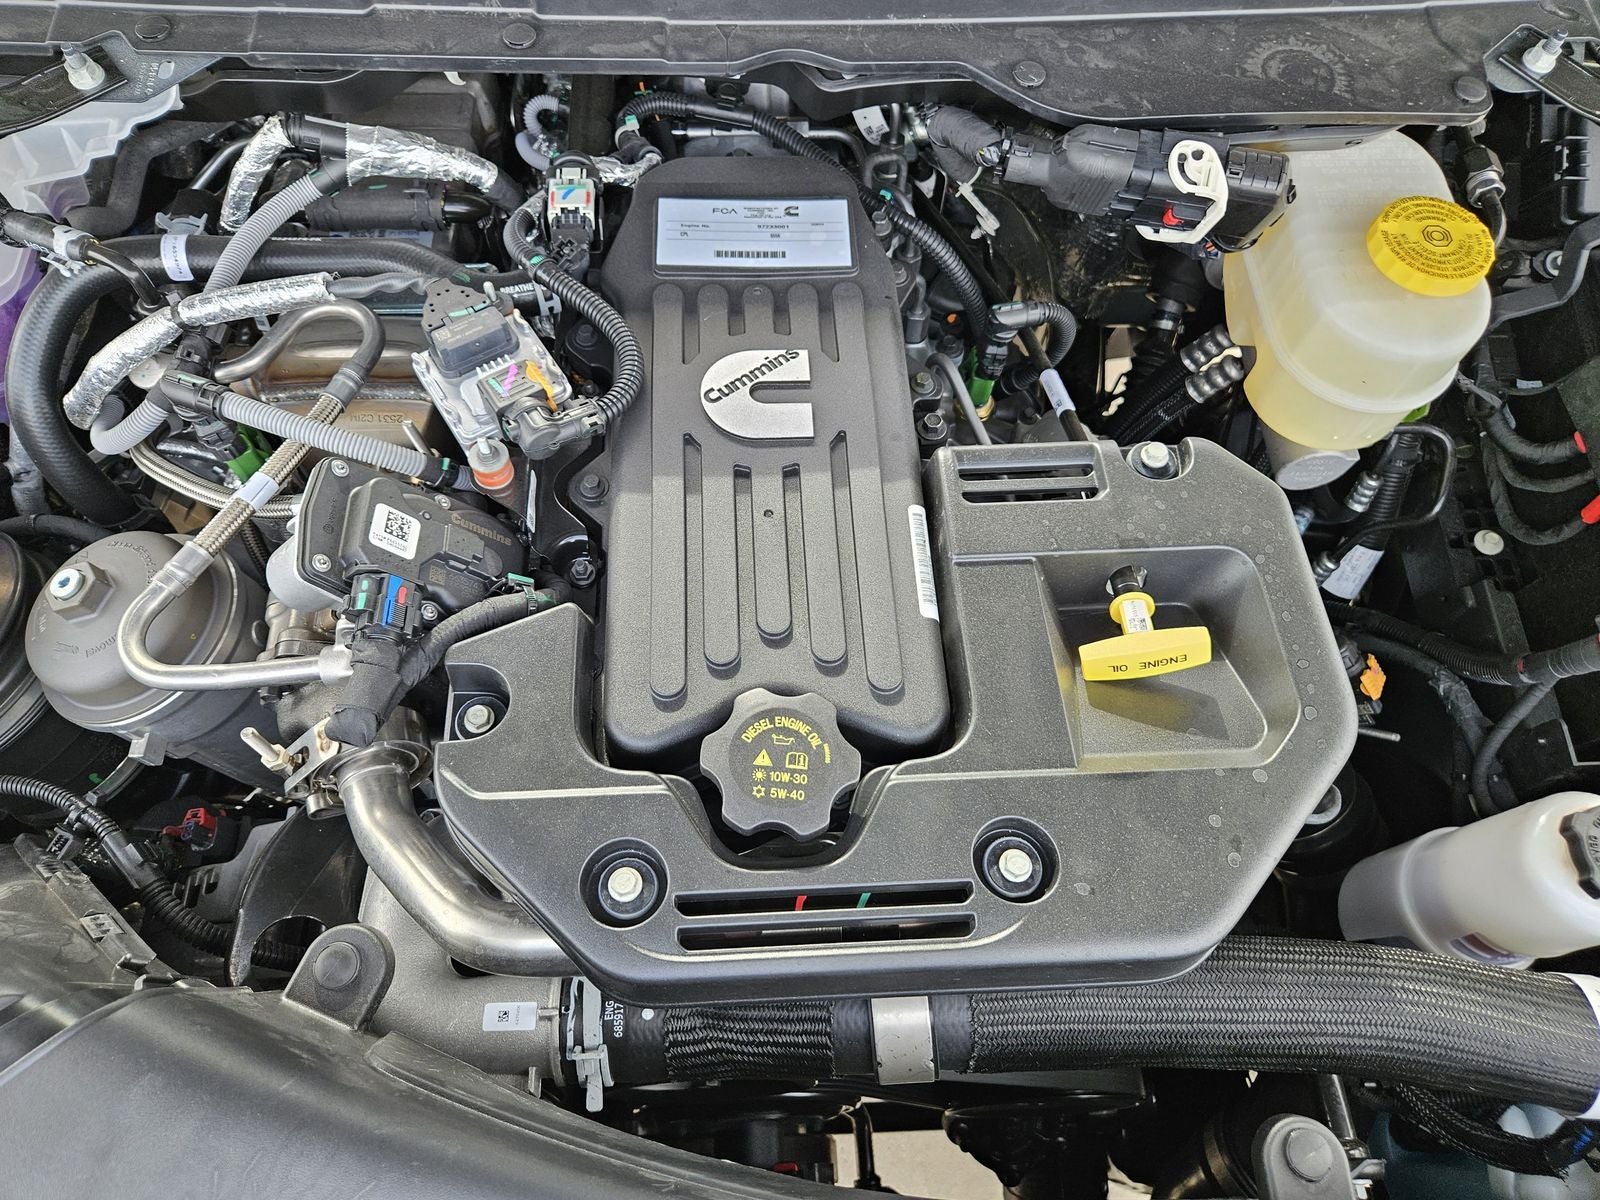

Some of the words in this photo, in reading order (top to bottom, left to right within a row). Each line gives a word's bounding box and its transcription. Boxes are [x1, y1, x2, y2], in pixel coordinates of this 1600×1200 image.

[712, 207, 738, 215] FCA
[499, 282, 535, 294] BREATHE
[703, 349, 800, 404] Cummins
[451, 512, 512, 546] Cummins
[1107, 664, 1128, 673] OIL
[1138, 654, 1188, 670] ENGINE
[741, 718, 774, 743] DIESEL
[774, 716, 811, 736] ENGINE
[807, 732, 822, 750] OIL
[769, 771, 808, 785] 10W-30
[769, 787, 805, 801] 5W-40
[604, 1000, 614, 1021] ENG
